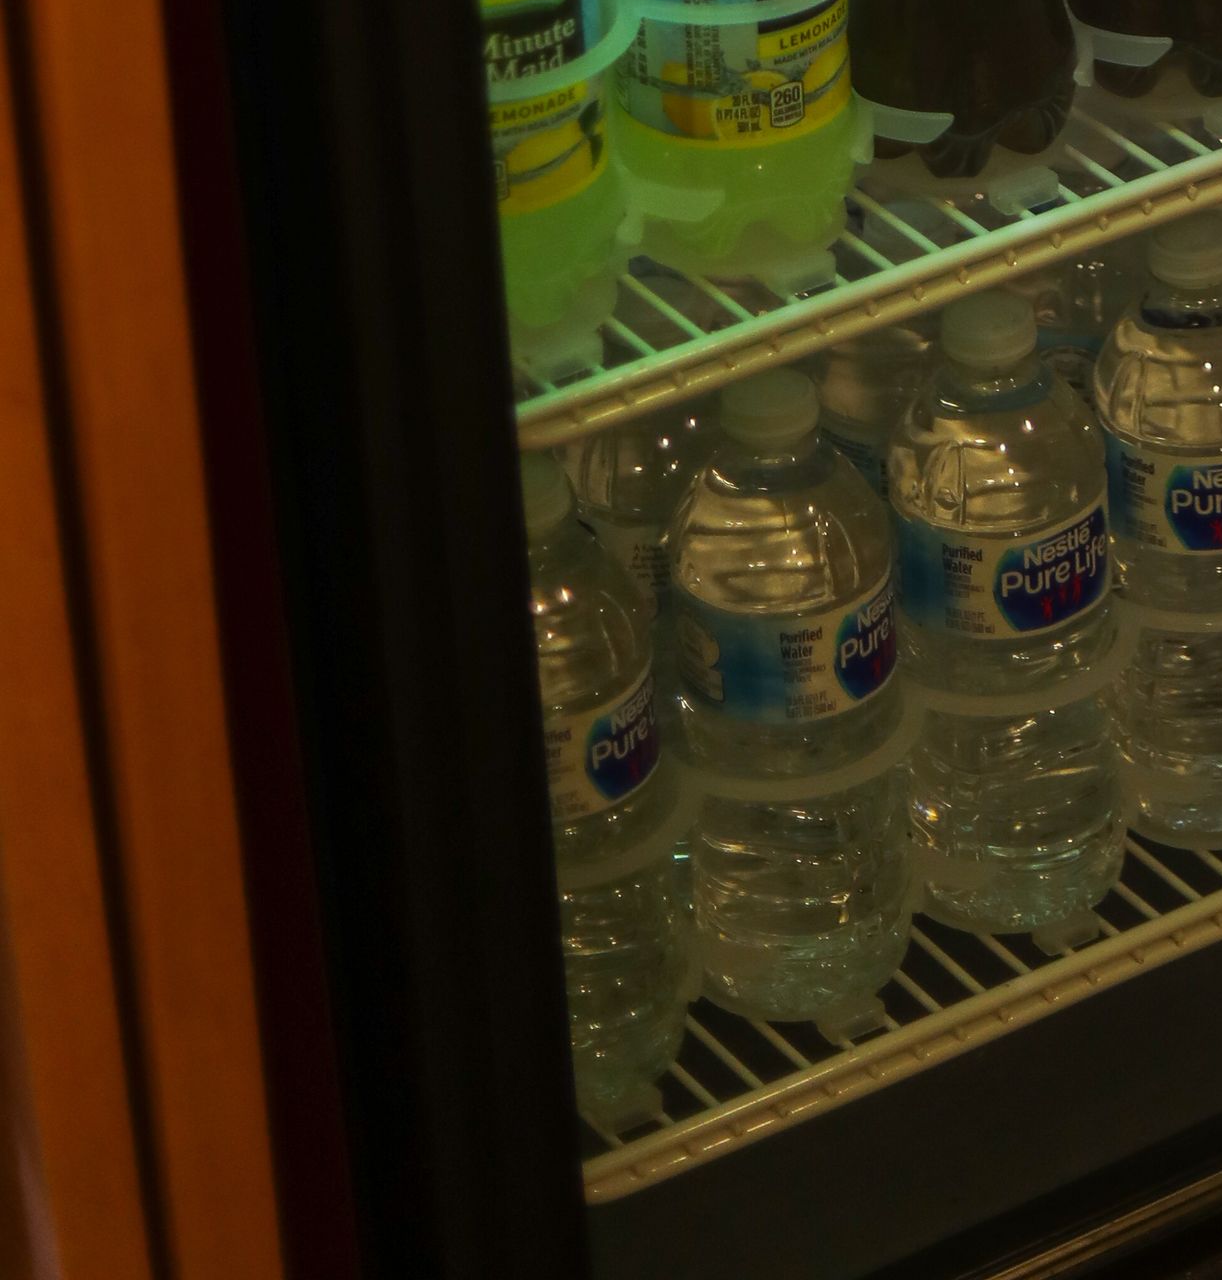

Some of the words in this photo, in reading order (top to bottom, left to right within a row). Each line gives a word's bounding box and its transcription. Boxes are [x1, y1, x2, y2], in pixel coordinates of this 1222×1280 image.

[490, 88, 576, 125] EMONADE
[774, 88, 800, 108] 260
[942, 543, 983, 562] Purified
[943, 558, 973, 575] Water
[1001, 561, 1071, 598] Pure
[1075, 534, 1106, 577] Life
[780, 626, 823, 643] Purified
[840, 616, 889, 669] Pure
[780, 645, 814, 660] Water
[592, 716, 649, 770] Pure
